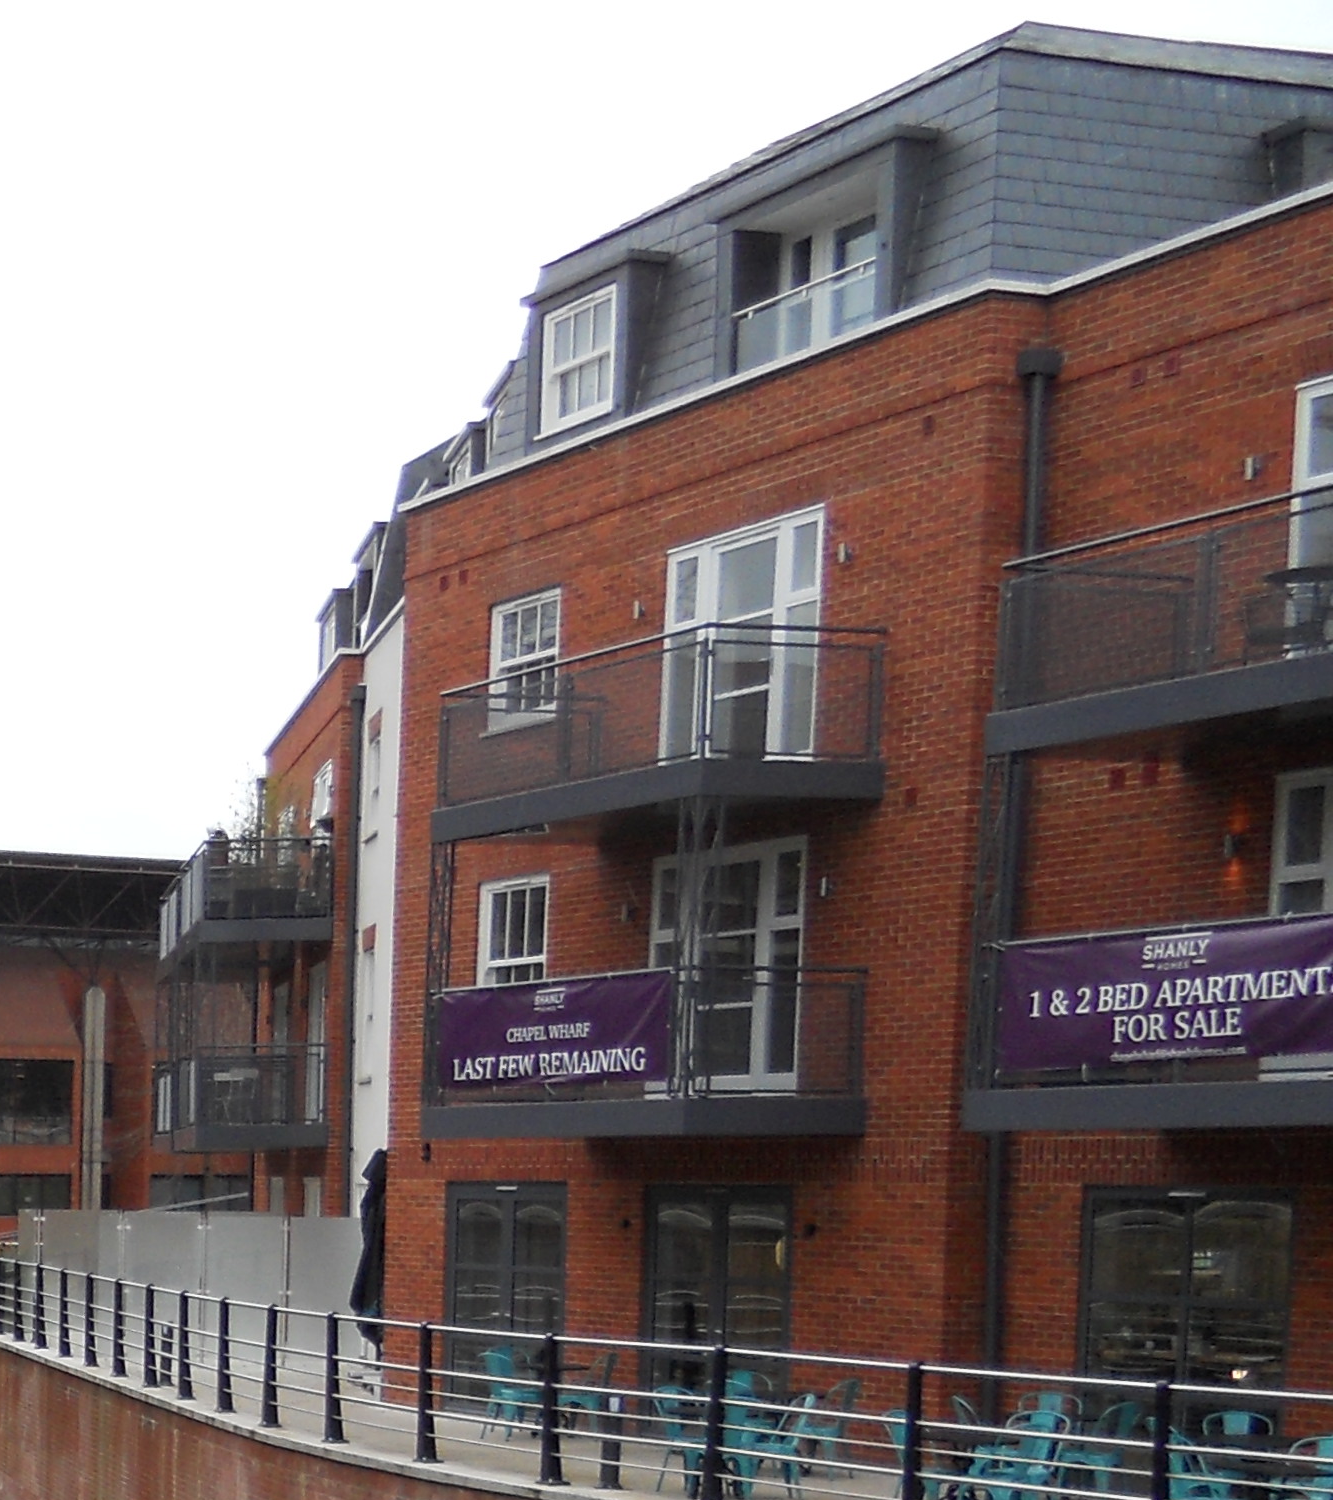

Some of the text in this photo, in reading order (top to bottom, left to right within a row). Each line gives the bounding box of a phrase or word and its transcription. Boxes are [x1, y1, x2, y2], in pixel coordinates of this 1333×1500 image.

[1142, 939, 1210, 960] SHANLY
[1029, 966, 1333, 1018] 1 & 2 BED APARTMENT
[506, 1022, 591, 1044] CHAPEL WHARF
[1113, 1008, 1242, 1043] FOR SALE
[453, 1047, 646, 1082] LAST FEW REMAINING
